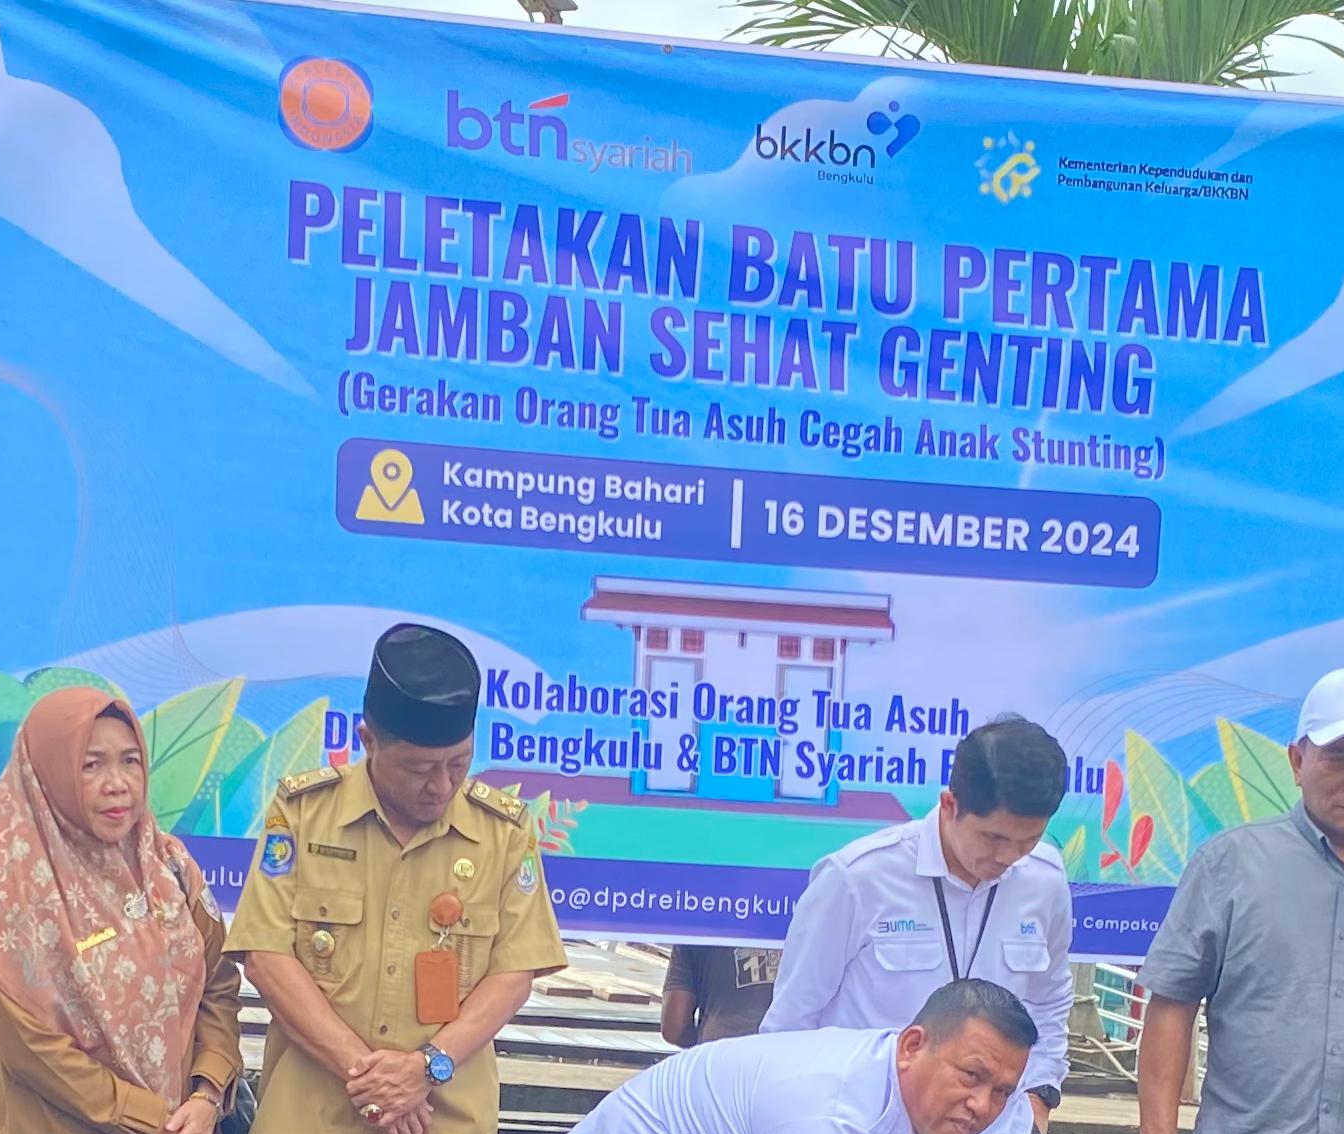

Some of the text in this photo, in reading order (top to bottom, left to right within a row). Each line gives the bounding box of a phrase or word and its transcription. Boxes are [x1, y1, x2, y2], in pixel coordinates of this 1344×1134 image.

[447, 89, 693, 176] btn syariah
[756, 124, 876, 169] bkkbn
[817, 170, 875, 185] Bengkulu
[1057, 174, 1249, 201] Pembangunan Keluarga/BKKBN
[1058, 156, 1253, 185] Kementerian Kependudukan dan
[288, 179, 1269, 346] PELETAKAN BATU PERTAMA
[346, 277, 1156, 418] JAMBAN SEHAT GENTING
[338, 369, 1166, 481] (Gerakan Orang Tua Asuh Cegah Anak Stunting)
[443, 460, 705, 506] Kampung Bahari
[442, 499, 663, 544] Kota Bengkulu
[764, 500, 1141, 559] 16 DESEMBER 2024
[486, 668, 970, 737] Kolaborasi Orang Tua Asuh
[490, 722, 663, 776] Bengkulu
[677, 733, 700, 773] &
[714, 736, 782, 778] BTN
[795, 740, 927, 787] Syariah
[1082, 915, 1159, 934] Cempaka
